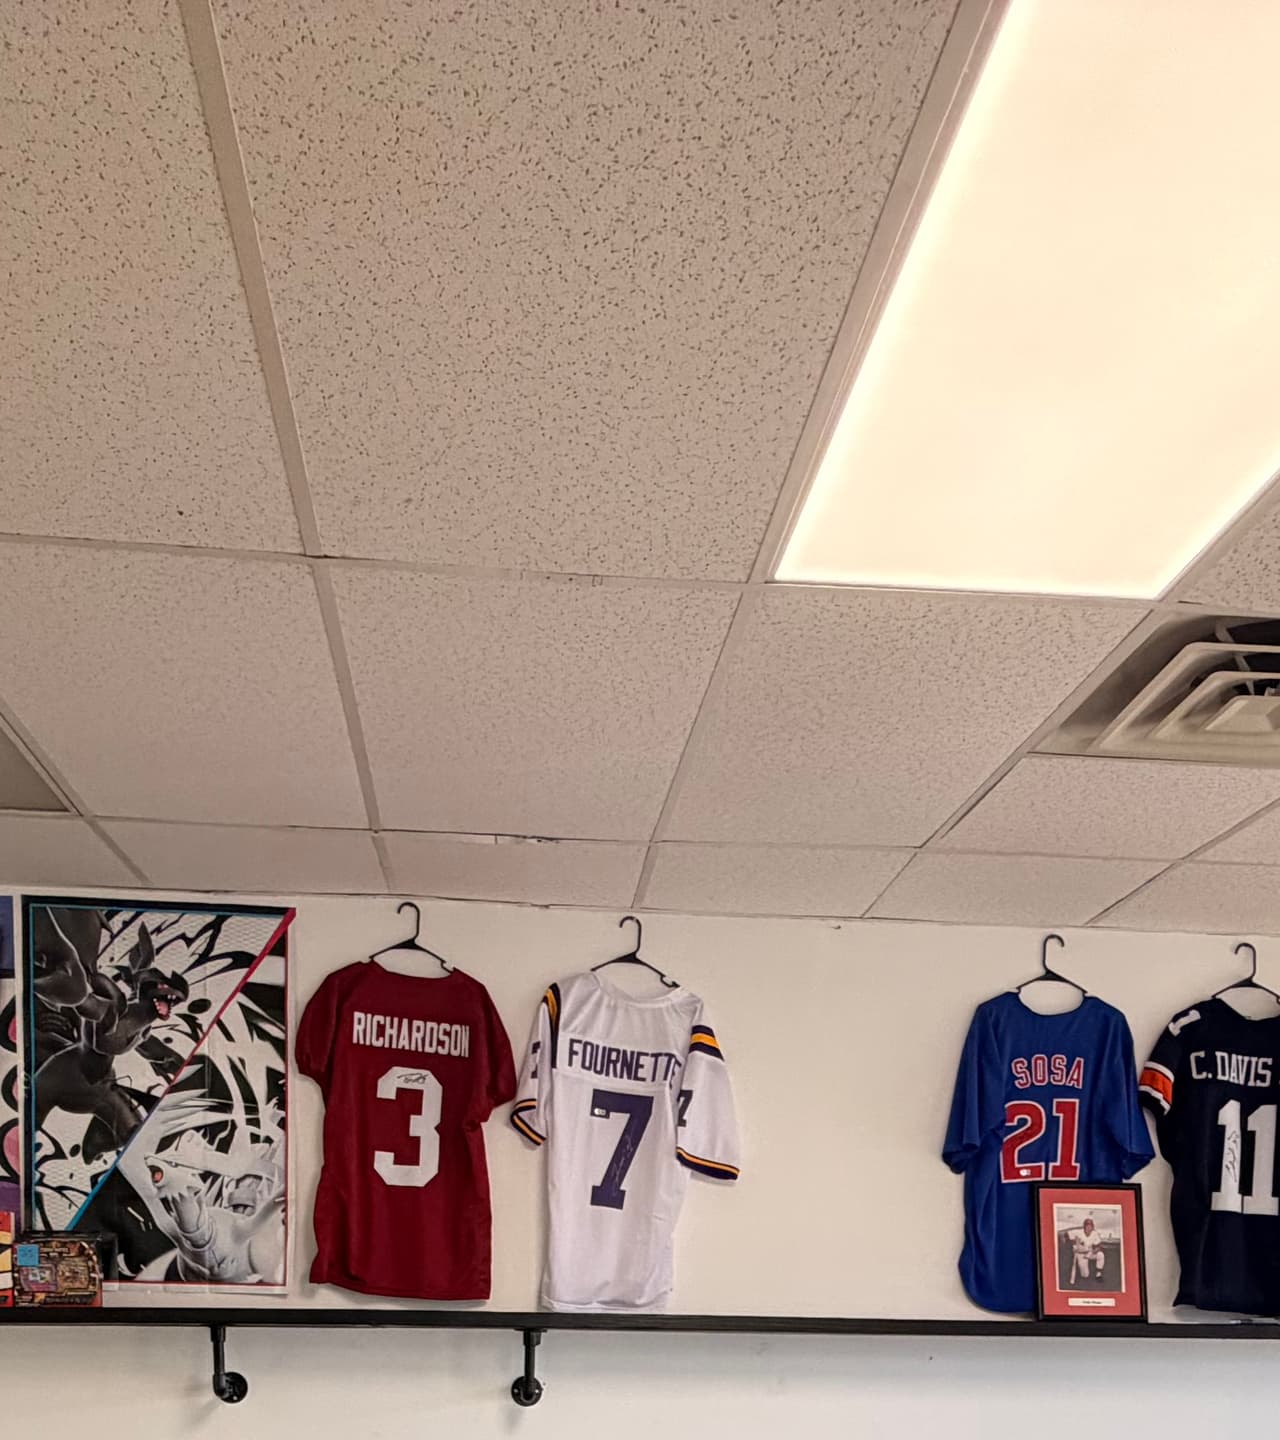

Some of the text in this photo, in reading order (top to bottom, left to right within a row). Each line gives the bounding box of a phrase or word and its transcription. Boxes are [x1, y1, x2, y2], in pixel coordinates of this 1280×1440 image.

[352, 1011, 470, 1058] RICHARDSON
[1011, 1054, 1084, 1089] SOSA
[1215, 1051, 1272, 1087] DAVIS
[373, 1066, 443, 1188] 3
[590, 1088, 654, 1210] 7
[1000, 1098, 1080, 1183] 21
[1210, 1099, 1279, 1216] 11
